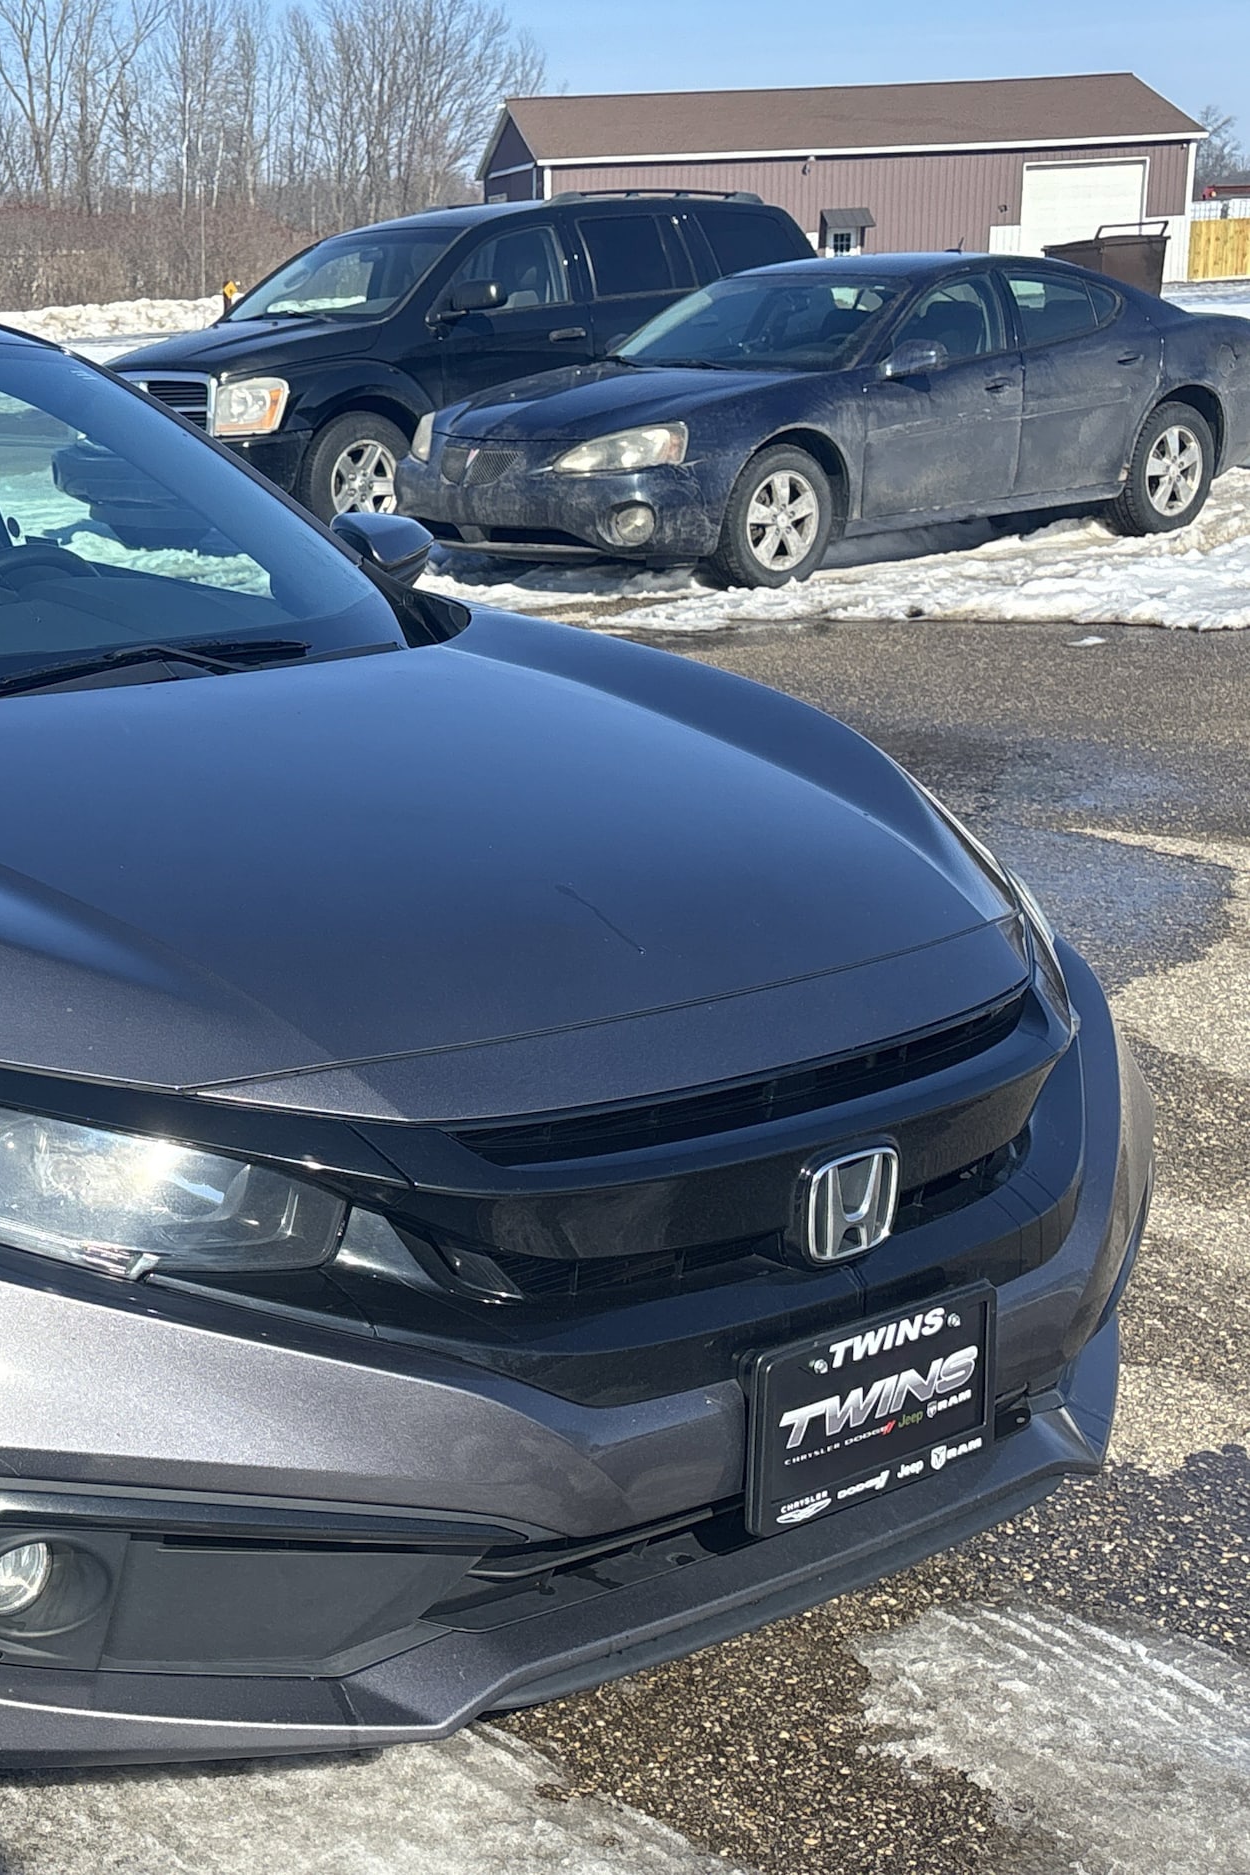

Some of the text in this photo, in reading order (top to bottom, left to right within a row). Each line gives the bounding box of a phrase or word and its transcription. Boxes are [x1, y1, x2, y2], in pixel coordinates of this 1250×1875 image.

[829, 1307, 945, 1368] TWINS
[779, 1345, 978, 1449] TWINS
[784, 1442, 840, 1465] CHRYSLER
[898, 1411, 924, 1428] Jeep
[937, 1390, 971, 1411] RAM
[780, 1490, 828, 1513] CHRYSLER
[897, 1460, 924, 1478] Jeep
[946, 1437, 982, 1459] RAM
